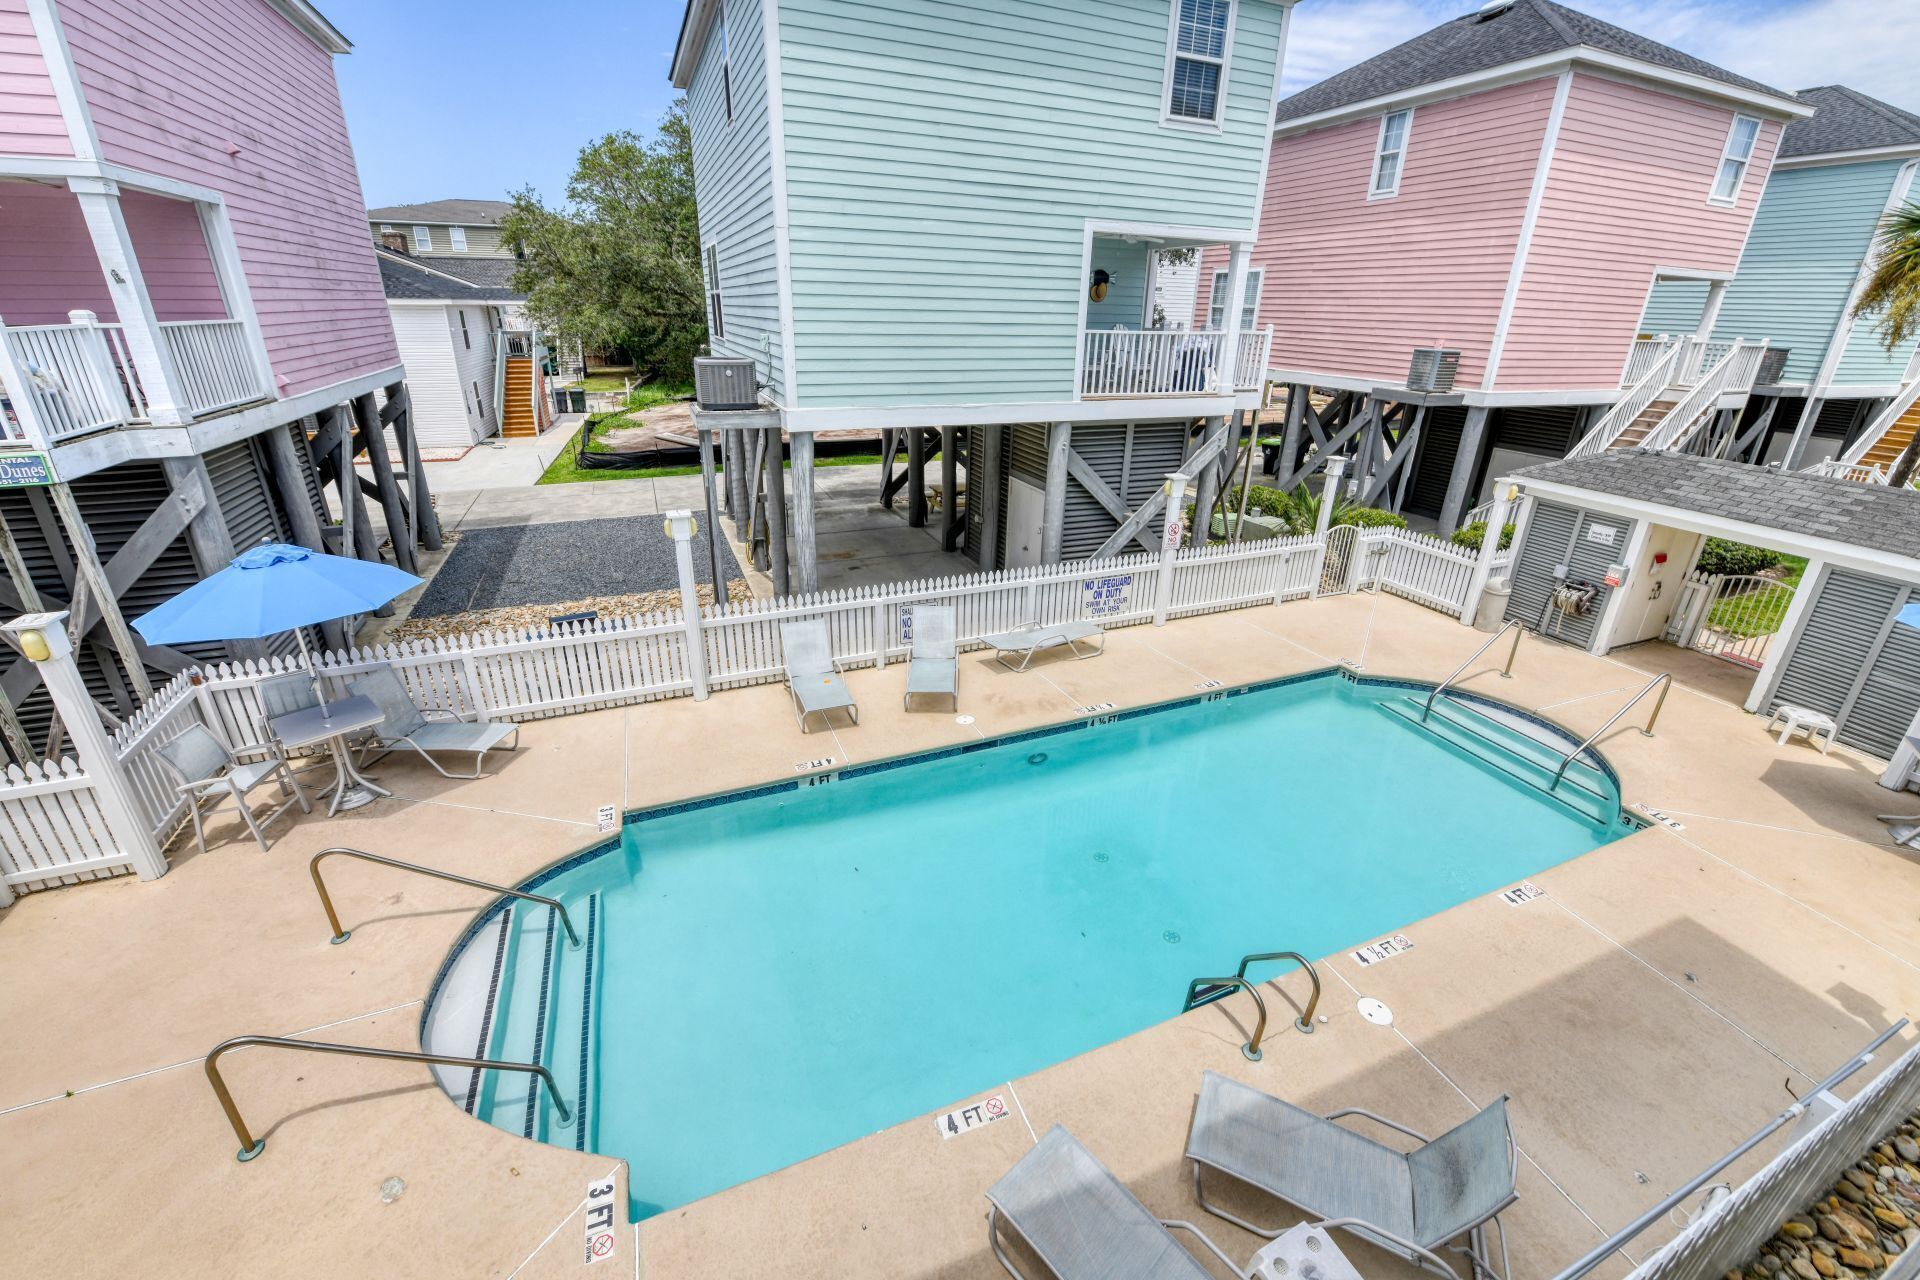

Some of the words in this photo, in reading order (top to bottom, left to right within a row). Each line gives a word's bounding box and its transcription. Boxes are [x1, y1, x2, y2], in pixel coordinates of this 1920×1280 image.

[0, 464, 46, 479] Dunes
[0, 477, 40, 485] 51-2116
[1084, 580, 1094, 591] NO
[1097, 576, 1132, 589] LIFEGUARD
[1093, 590, 1102, 600] ON
[1106, 587, 1123, 599] DUTY
[1085, 601, 1100, 609] SWIM
[1113, 597, 1128, 605] YOUR
[1092, 607, 1105, 615] OWN
[1108, 604, 1121, 613] RISK
[902, 617, 912, 628] NO
[1214, 692, 1224, 701] FT
[1108, 714, 1118, 724] FT
[810, 760, 823, 769] FT
[819, 774, 831, 785] FT
[600, 812, 613, 822] FT
[1622, 816, 1632, 826] 3
[1649, 812, 1669, 822] FT
[1511, 888, 1532, 901] FT
[1355, 951, 1370, 964] 4
[1379, 940, 1398, 955] FT
[947, 1113, 959, 1134] 4
[961, 1105, 983, 1128] FT
[589, 1184, 614, 1199] 3
[587, 1202, 614, 1231] FT
